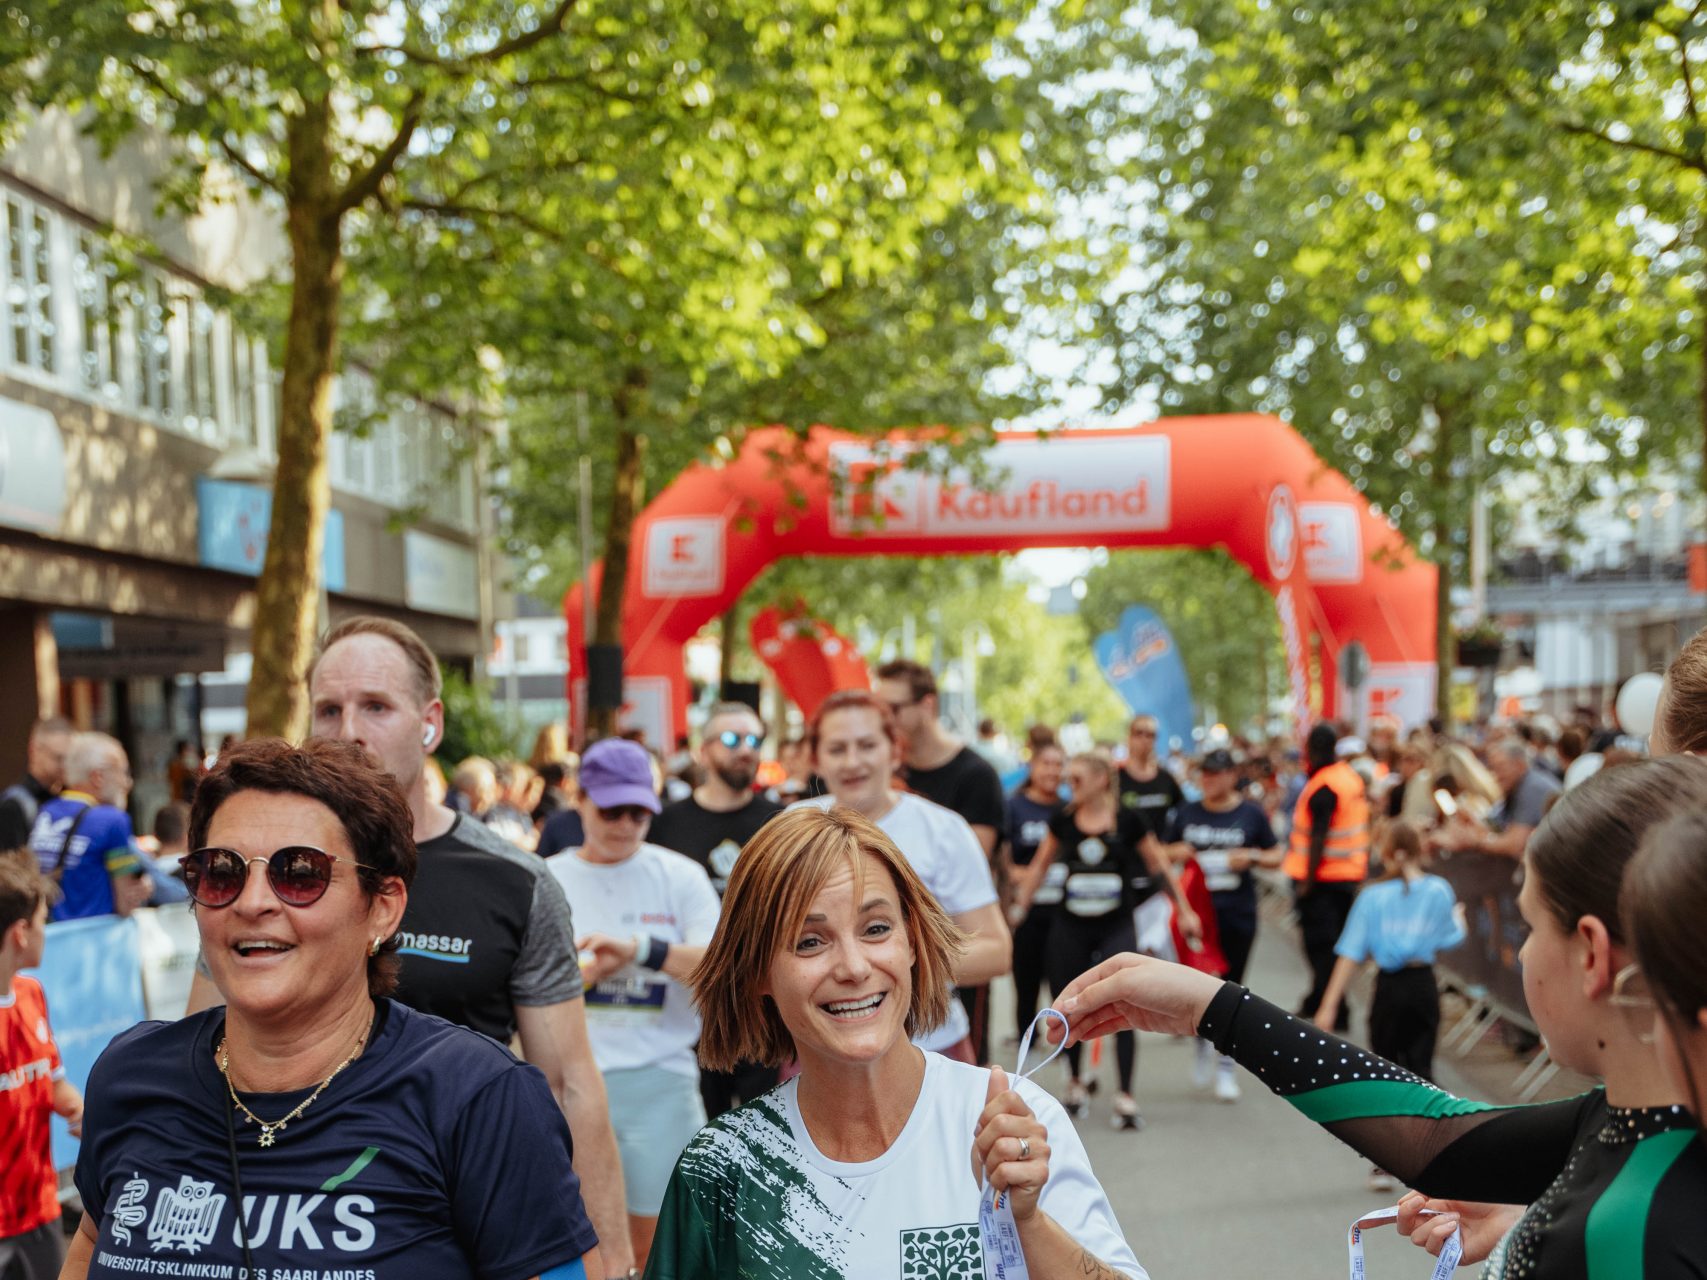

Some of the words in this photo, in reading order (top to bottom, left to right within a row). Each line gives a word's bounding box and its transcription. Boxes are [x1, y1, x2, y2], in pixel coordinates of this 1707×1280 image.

[936, 478, 1148, 520] Kaufland
[232, 1193, 376, 1251] UKS
[98, 1251, 233, 1279] UNIVERSITÄTSKLINIKUM
